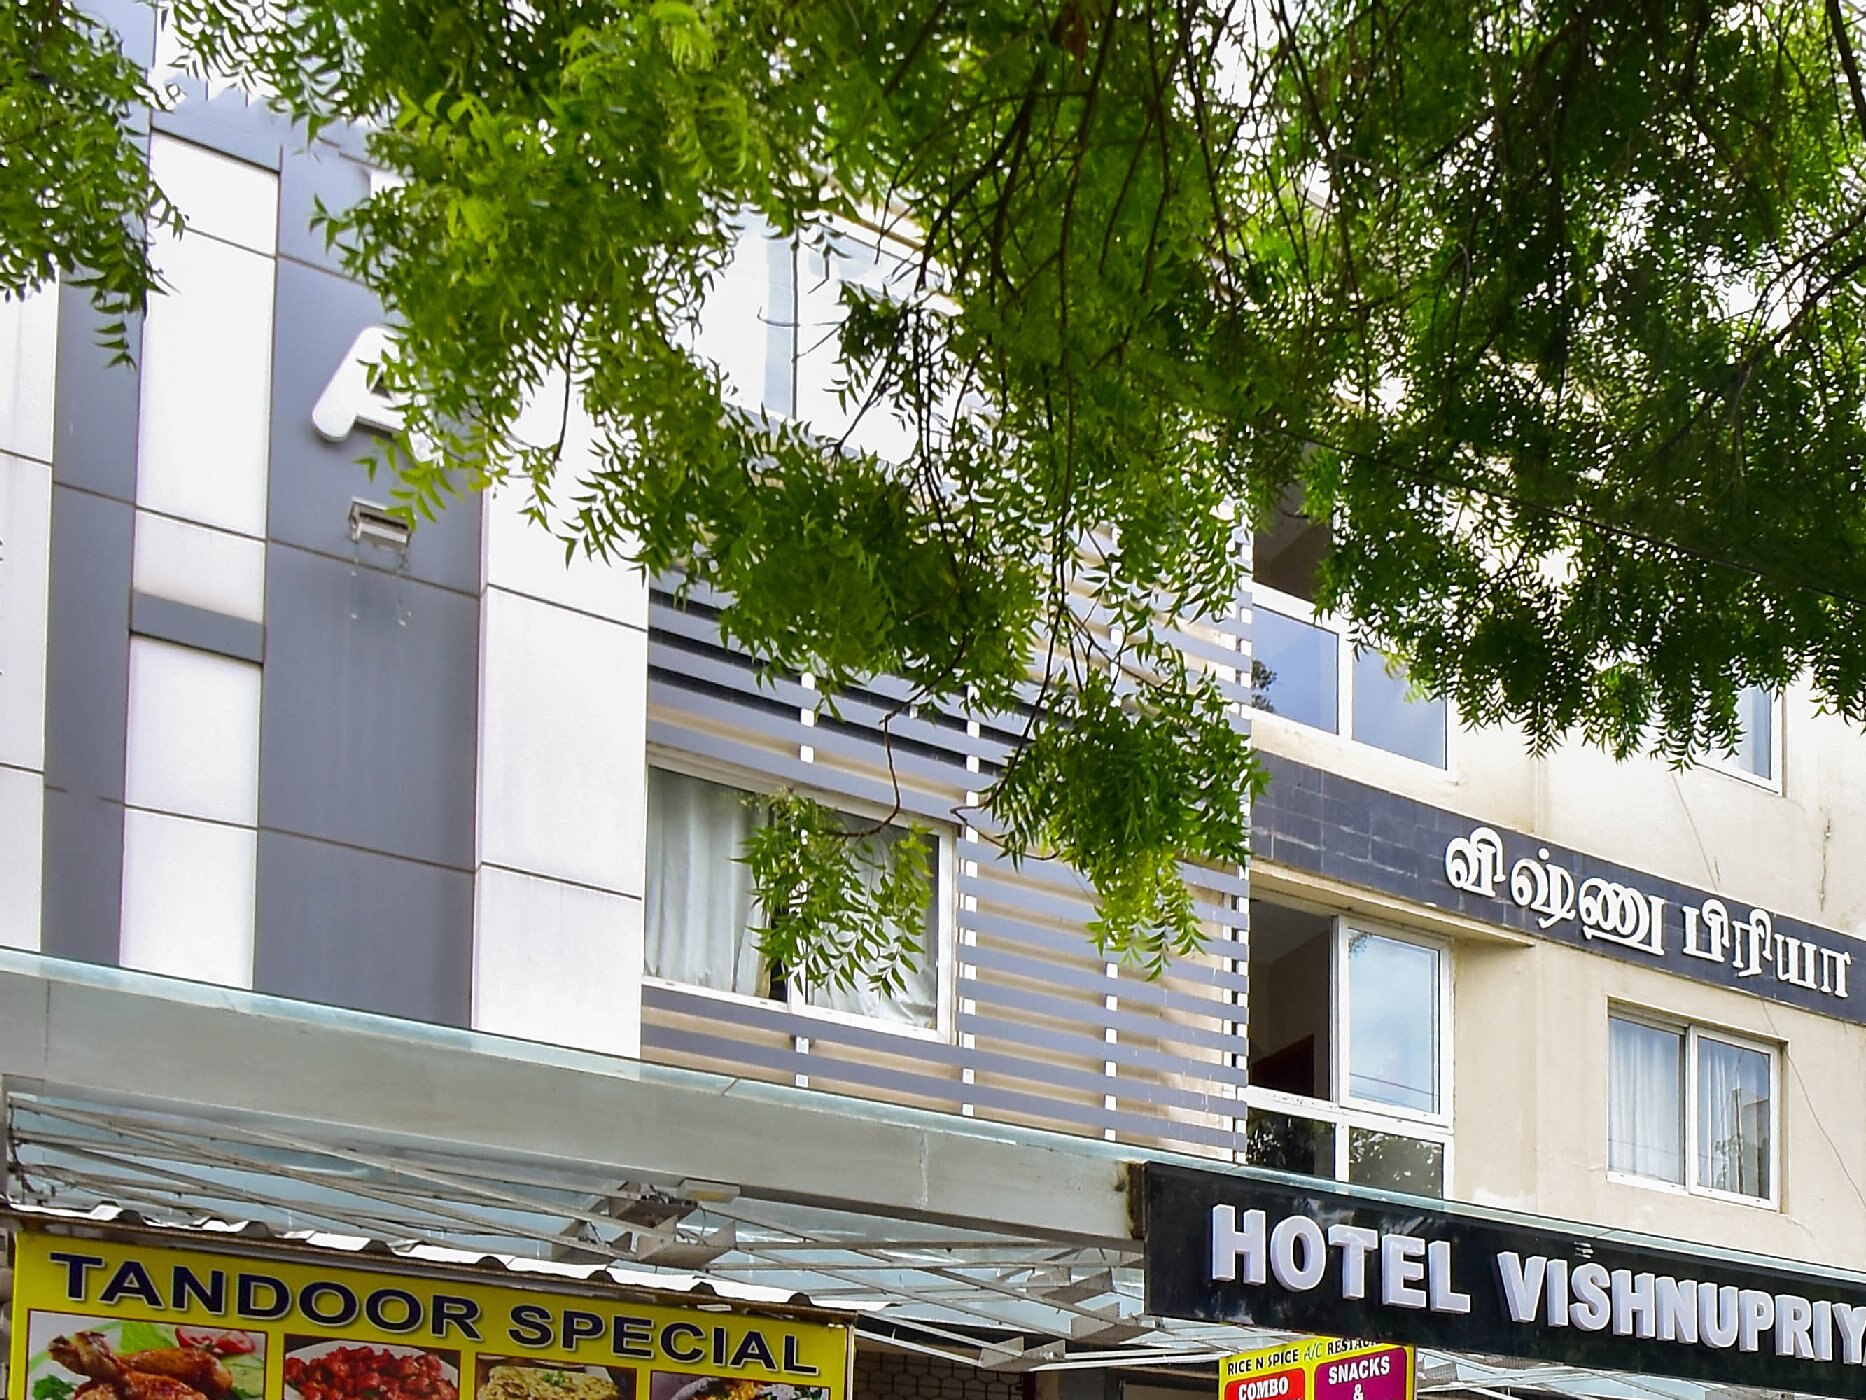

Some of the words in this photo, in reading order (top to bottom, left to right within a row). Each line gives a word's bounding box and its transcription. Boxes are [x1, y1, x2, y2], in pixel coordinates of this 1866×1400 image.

[1444, 826, 1665, 956] விஷ்ணு
[49, 1252, 485, 1343] TANDOOR
[508, 1303, 820, 1376] SPECIAL
[1210, 1203, 1471, 1315] HOTEL
[1228, 1359, 1252, 1376] RICE
[1255, 1357, 1264, 1370] N
[1268, 1349, 1299, 1368] SPICE
[1304, 1341, 1323, 1363] A/C
[1328, 1356, 1390, 1385] SNACKS
